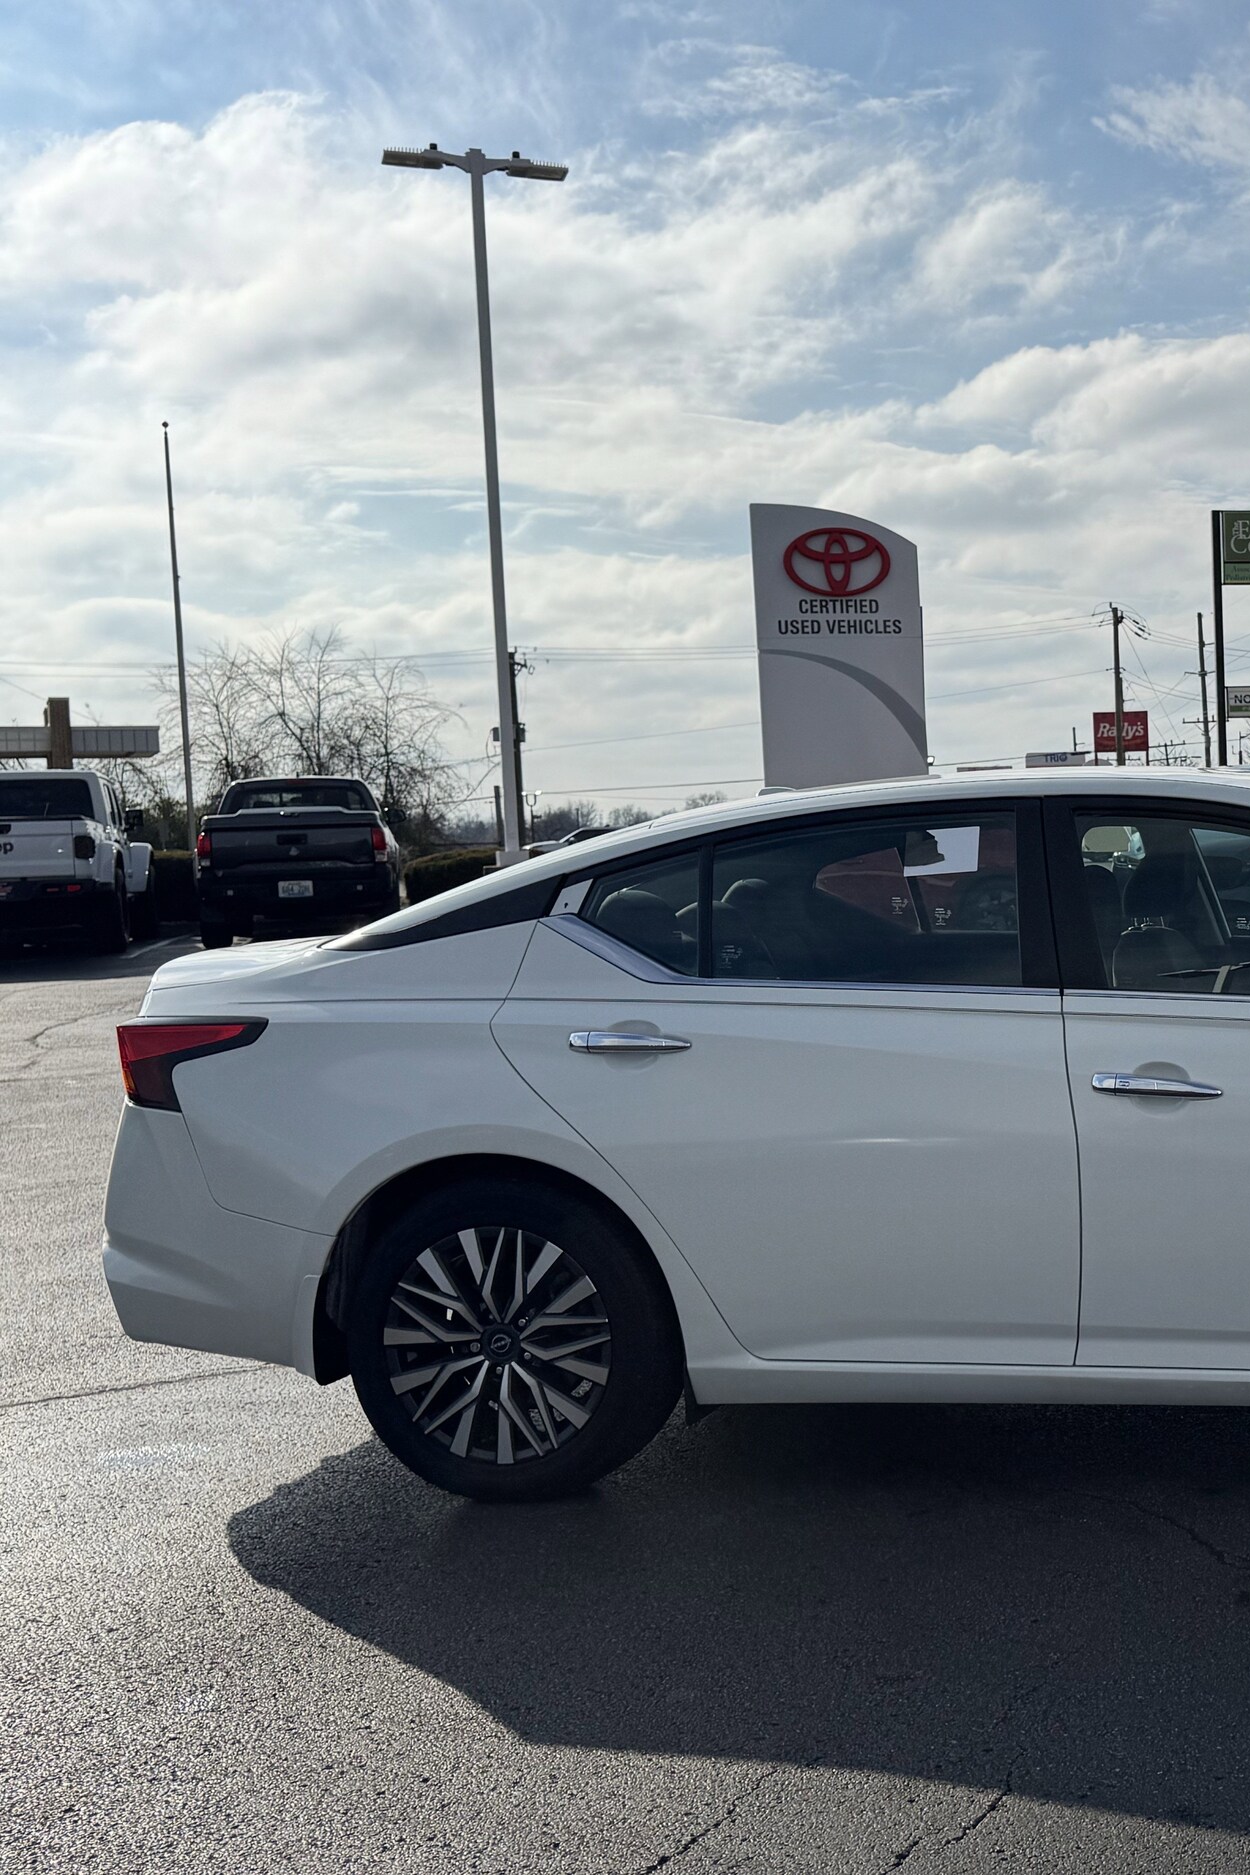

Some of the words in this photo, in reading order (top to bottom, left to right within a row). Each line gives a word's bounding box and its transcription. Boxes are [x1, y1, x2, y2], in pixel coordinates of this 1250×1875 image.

[799, 599, 879, 614] CERTIFIED
[778, 619, 821, 635] USED
[826, 619, 902, 634] VEHICLES
